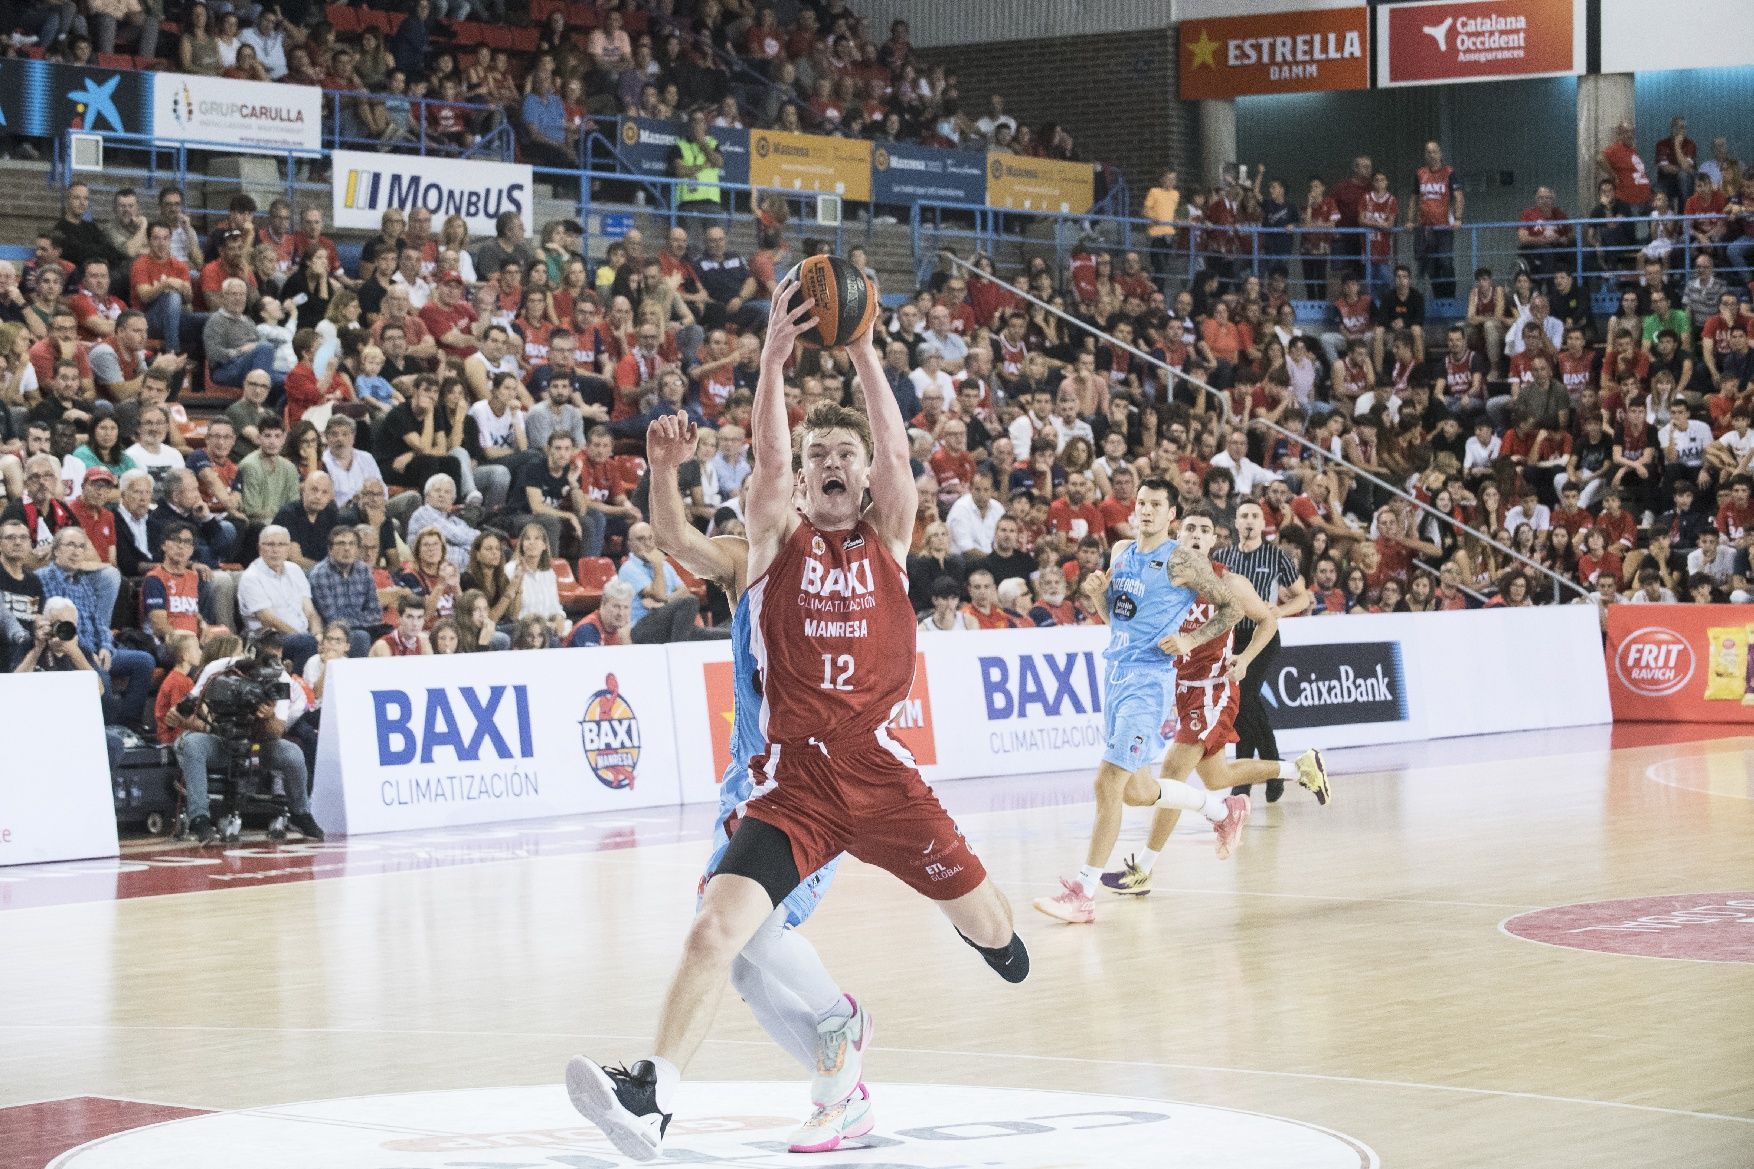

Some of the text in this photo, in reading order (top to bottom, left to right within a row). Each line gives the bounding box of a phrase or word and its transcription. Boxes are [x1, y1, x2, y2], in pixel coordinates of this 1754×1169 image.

[1456, 13, 1527, 33] Catalana
[1227, 30, 1362, 67] ESTRELLA
[1456, 31, 1526, 51] Occident
[1270, 63, 1319, 81] DAMM
[387, 173, 525, 220] MONBUS
[800, 556, 875, 597] BAXI
[797, 592, 876, 613] CLIMATIZACIÓN
[804, 617, 868, 638] MANRESA
[1626, 643, 1685, 668] FRIT
[820, 653, 856, 691] 12
[978, 650, 1103, 721] BAXI
[1278, 663, 1393, 708] CaixaBank
[1631, 667, 1676, 681] RAVICH
[370, 684, 535, 767] BAXI
[582, 718, 641, 751] BAXI
[380, 765, 540, 807] CLIMATIZACIÓN
[925, 862, 947, 875] ETL
[931, 863, 964, 882] GLOBAL
